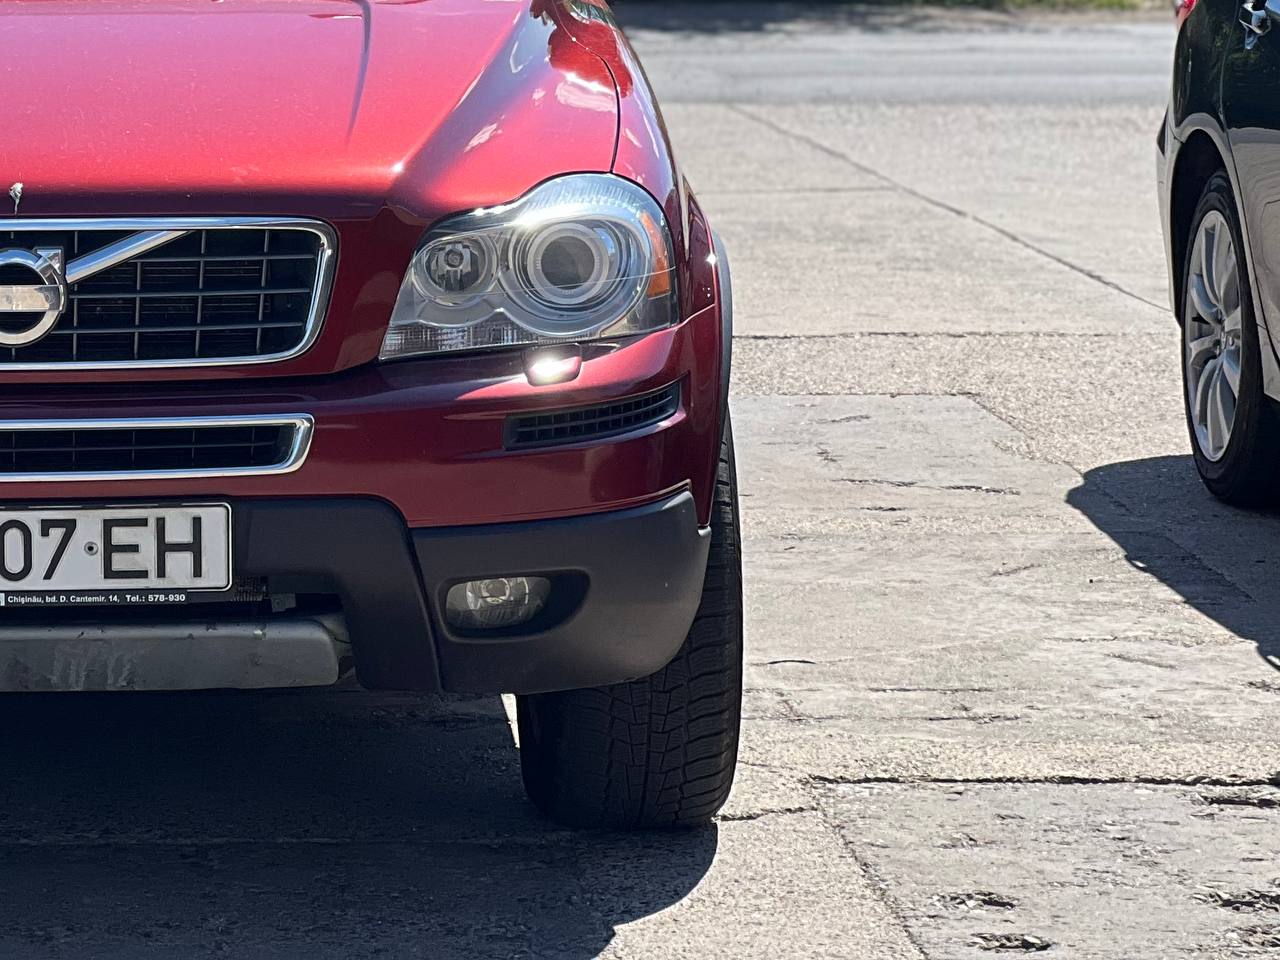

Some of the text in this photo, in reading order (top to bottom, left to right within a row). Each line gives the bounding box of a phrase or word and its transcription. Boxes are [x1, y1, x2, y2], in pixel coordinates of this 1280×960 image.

[103, 517, 202, 578] EH
[45, 595, 57, 603] bd.
[108, 594, 120, 603] 14,
[125, 594, 146, 602] Tel.:
[147, 593, 186, 602] 578-930
